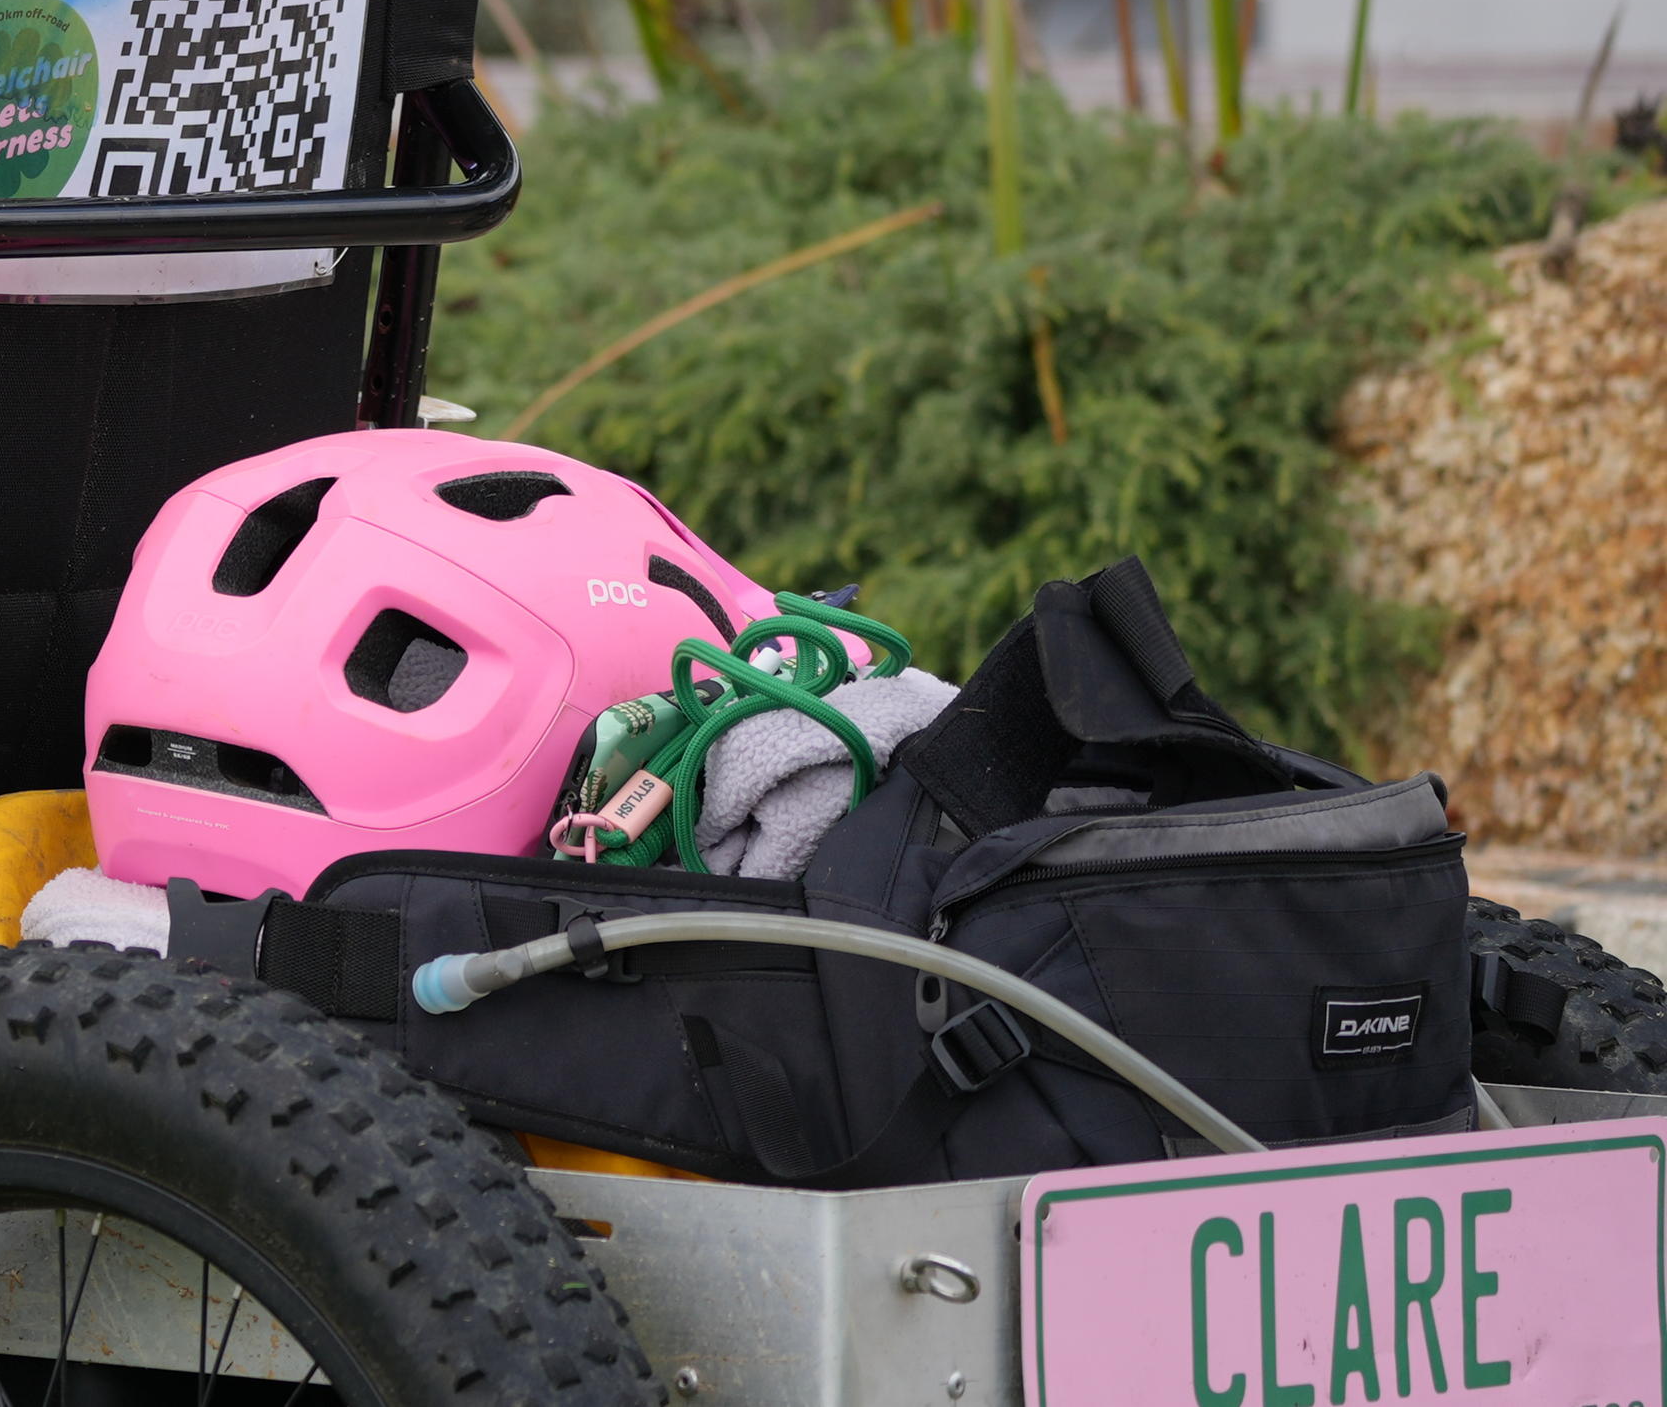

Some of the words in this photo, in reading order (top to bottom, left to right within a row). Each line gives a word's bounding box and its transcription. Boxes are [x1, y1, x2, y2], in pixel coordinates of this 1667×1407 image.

[25, 8, 71, 33] off-road
[614, 778, 656, 820] STYLISH
[1335, 1014, 1411, 1037] DAKINE
[1191, 1188, 1513, 1407] CLARE
